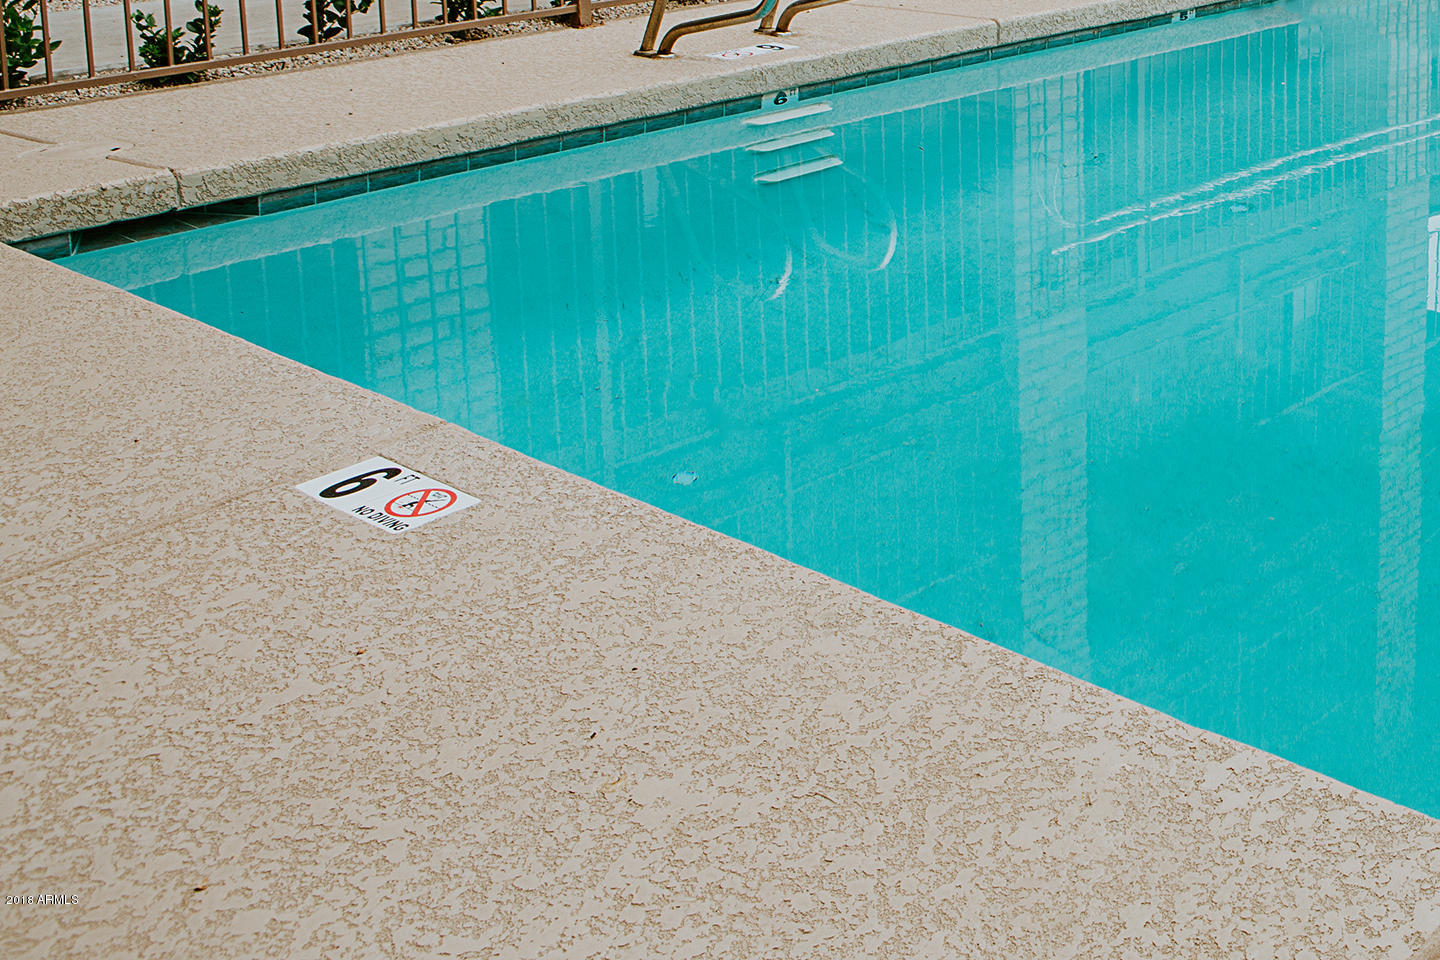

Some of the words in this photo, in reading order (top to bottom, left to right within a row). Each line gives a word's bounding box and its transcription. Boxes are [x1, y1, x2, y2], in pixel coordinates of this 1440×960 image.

[773, 90, 788, 106] 6
[318, 467, 403, 499] 6
[394, 474, 422, 485] FT
[351, 505, 376, 515] NO
[367, 512, 410, 530] DIVING
